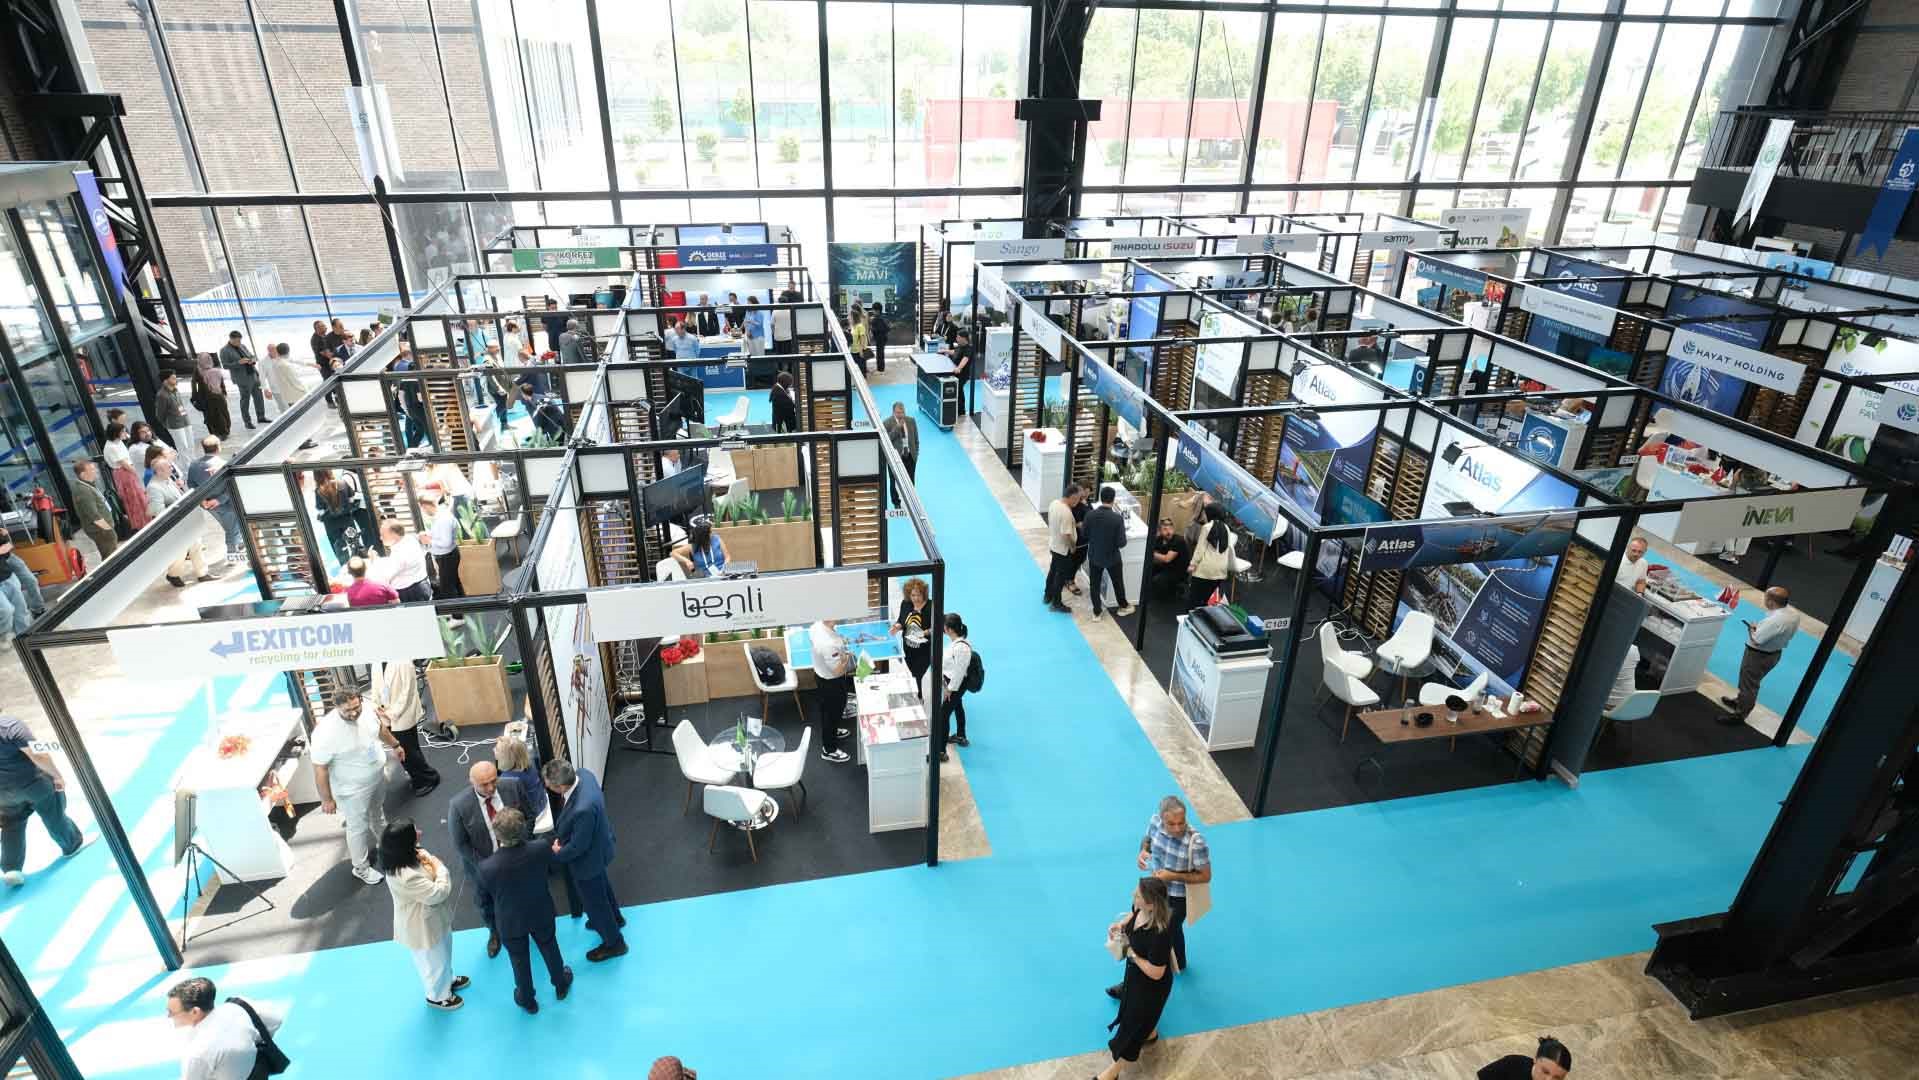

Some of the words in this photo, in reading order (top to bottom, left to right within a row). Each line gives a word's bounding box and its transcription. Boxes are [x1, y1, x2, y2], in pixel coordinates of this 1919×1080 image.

[1000, 242, 1040, 256] Sango
[1113, 242, 1160, 251] ANADOLU
[1163, 242, 1194, 250] ISUZU
[1696, 349, 1731, 365] HAYAT
[1734, 360, 1785, 381] HOLDING
[1459, 455, 1502, 492] Atlas
[1378, 539, 1416, 551] Atlas
[681, 585, 764, 618] benli
[246, 622, 353, 652] EXITCOM
[249, 653, 300, 665] recycling
[303, 650, 318, 661] for
[321, 647, 354, 658] future
